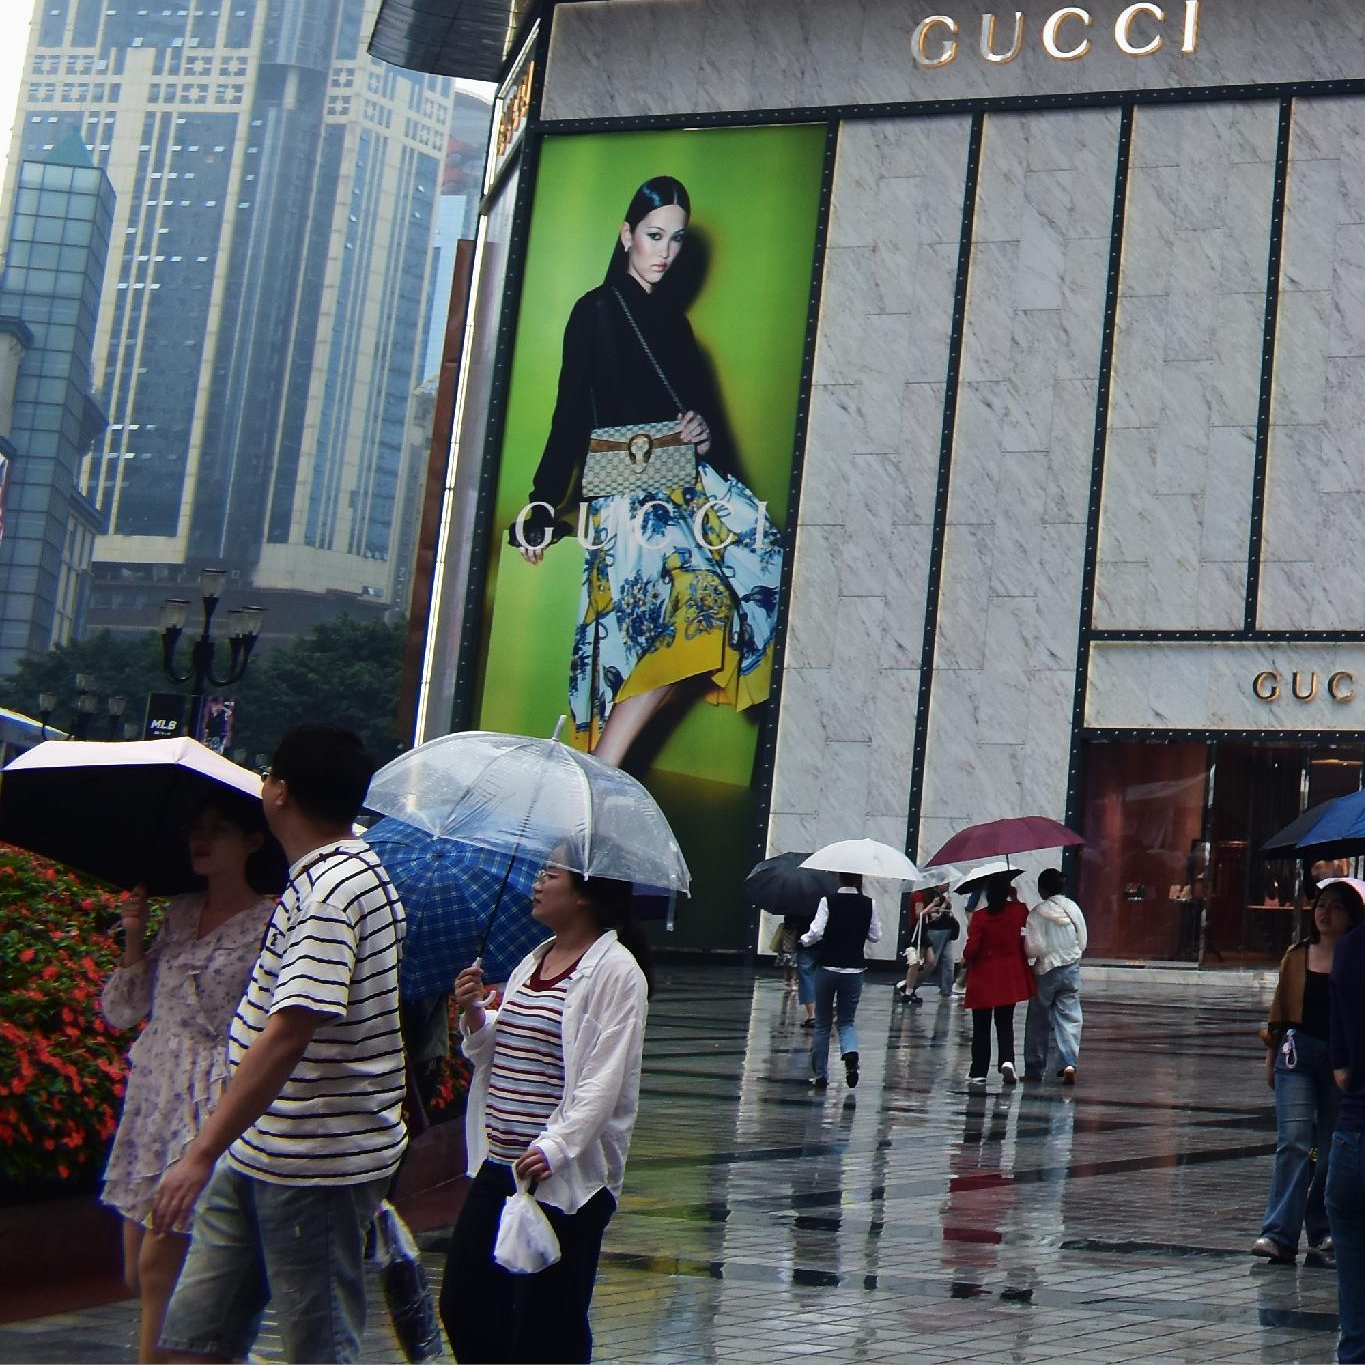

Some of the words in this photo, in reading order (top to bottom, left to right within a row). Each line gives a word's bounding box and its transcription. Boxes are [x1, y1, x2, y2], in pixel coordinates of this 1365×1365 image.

[910, 0, 1199, 69] GUCCI
[516, 501, 768, 550] GUCCI
[150, 719, 178, 730] MLB
